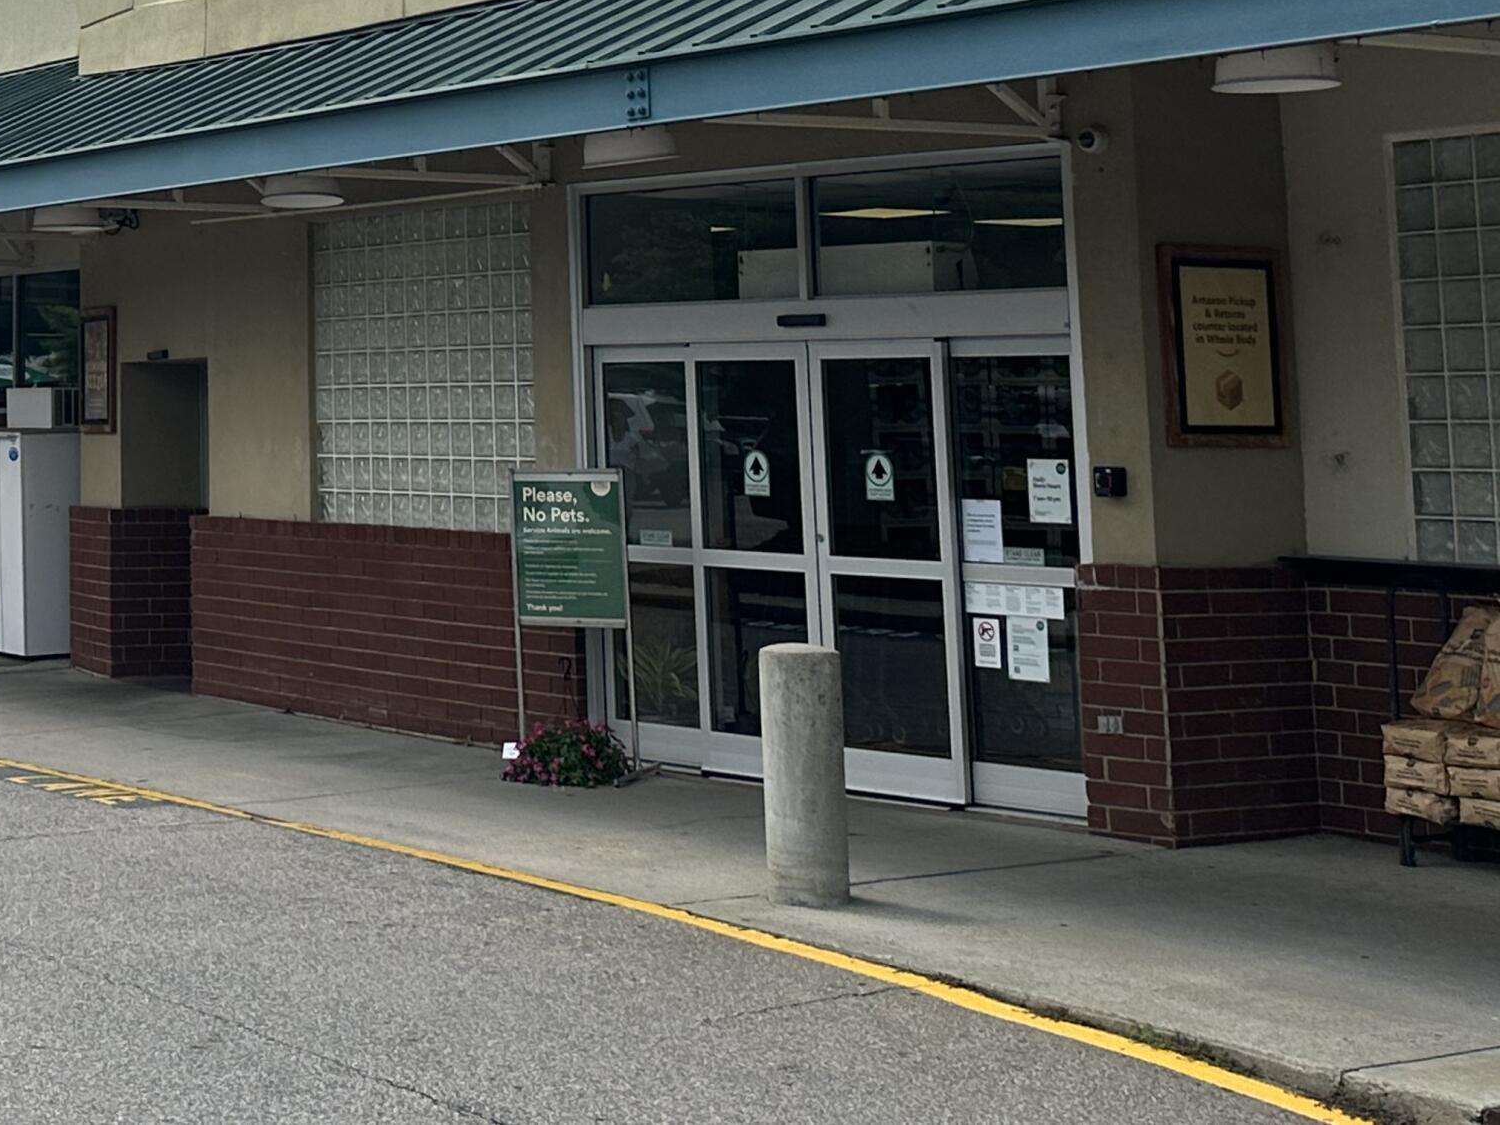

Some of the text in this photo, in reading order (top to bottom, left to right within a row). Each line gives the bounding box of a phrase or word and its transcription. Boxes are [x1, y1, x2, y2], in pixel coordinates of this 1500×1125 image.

[1192, 295, 1226, 305] Amazon
[522, 486, 578, 506] Please,
[523, 507, 590, 523] No Pets.
[526, 603, 547, 611] Thank
